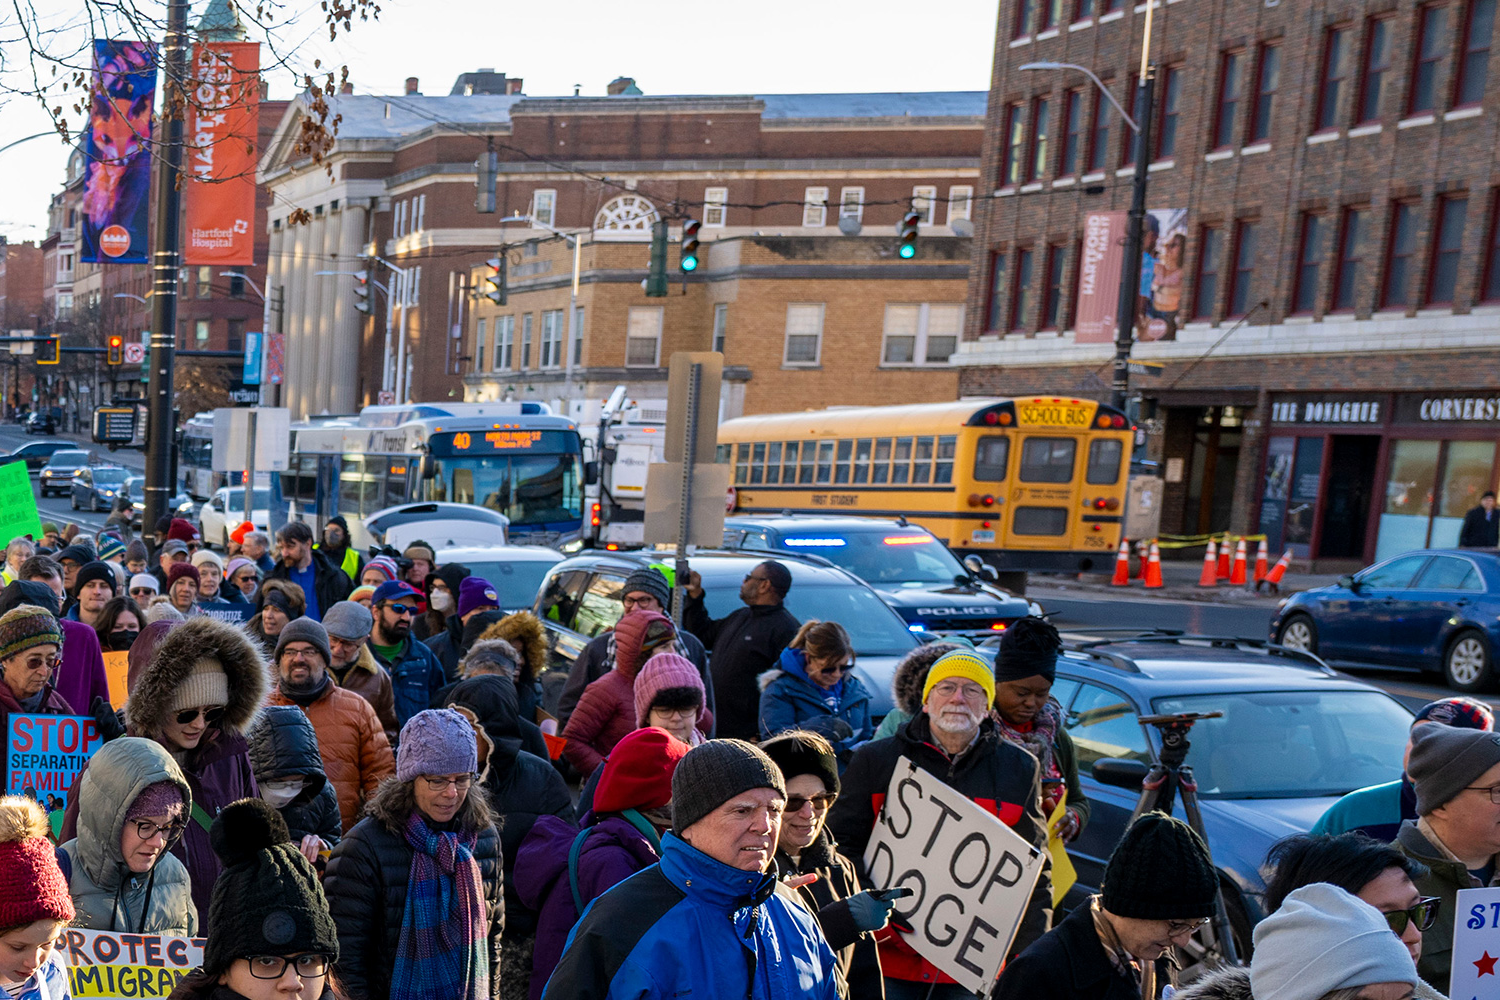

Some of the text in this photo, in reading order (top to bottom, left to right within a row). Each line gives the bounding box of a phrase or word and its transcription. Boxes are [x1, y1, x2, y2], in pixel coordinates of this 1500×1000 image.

[192, 228, 233, 239] Hartford
[192, 237, 233, 250] Hospital
[1022, 405, 1086, 425] SCHOOL BUS
[1272, 402, 1380, 423] THE DONAGHUE
[453, 432, 471, 450] 40
[916, 607, 998, 616] POLICE
[12, 716, 101, 754] STOP
[887, 777, 1024, 905] STOP
[866, 840, 1000, 978] DOGE
